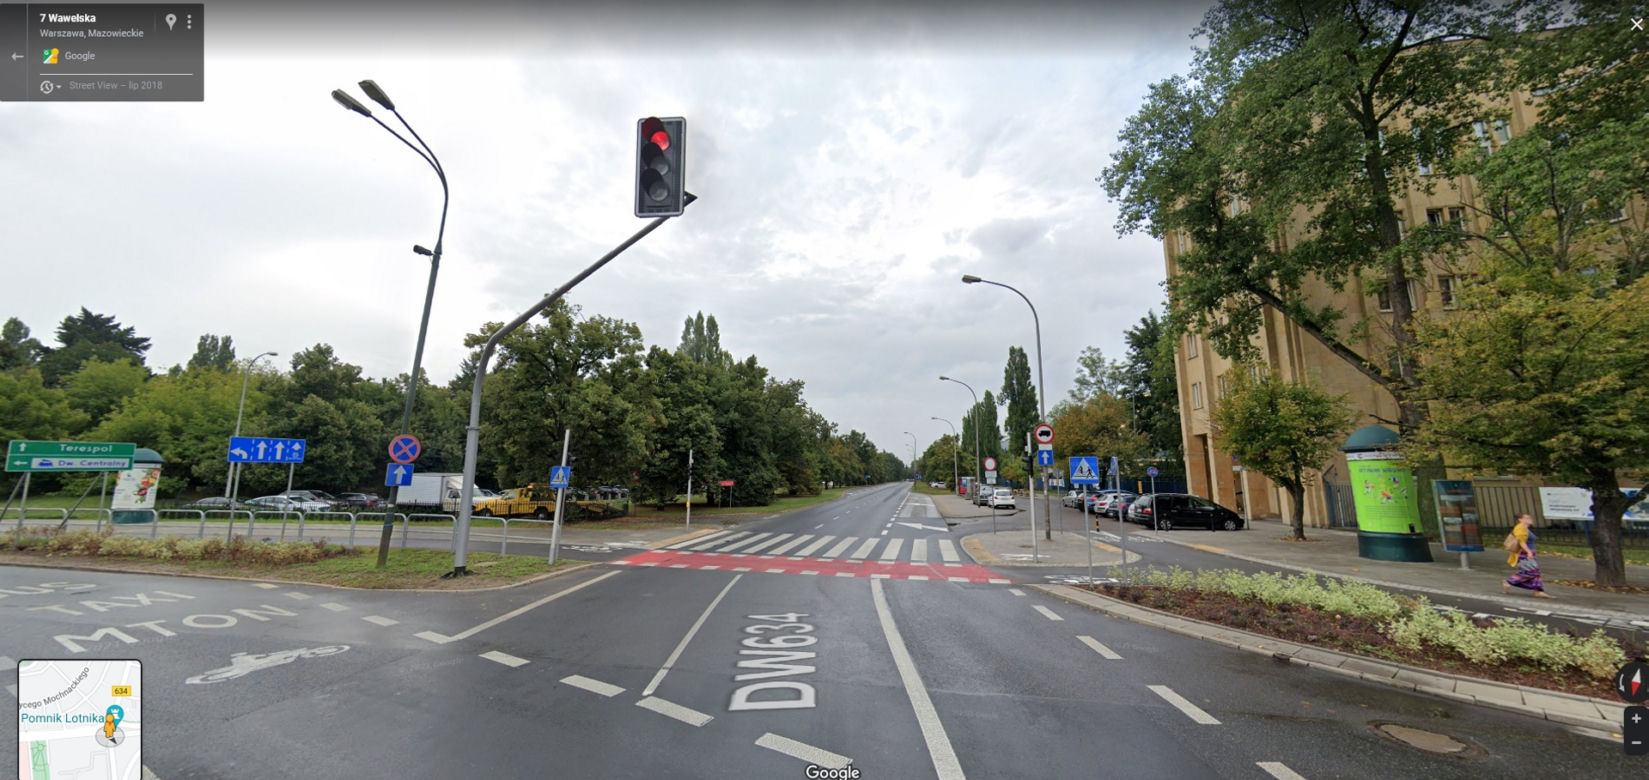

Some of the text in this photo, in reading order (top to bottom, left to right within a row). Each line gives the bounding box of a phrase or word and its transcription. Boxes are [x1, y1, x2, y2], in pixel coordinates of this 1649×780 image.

[59, 443, 113, 454] Terespol
[80, 459, 126, 468] Centralny
[0, 581, 97, 599] US
[27, 590, 197, 616] TAXI
[52, 604, 299, 653] MTON
[728, 613, 817, 710] DW634
